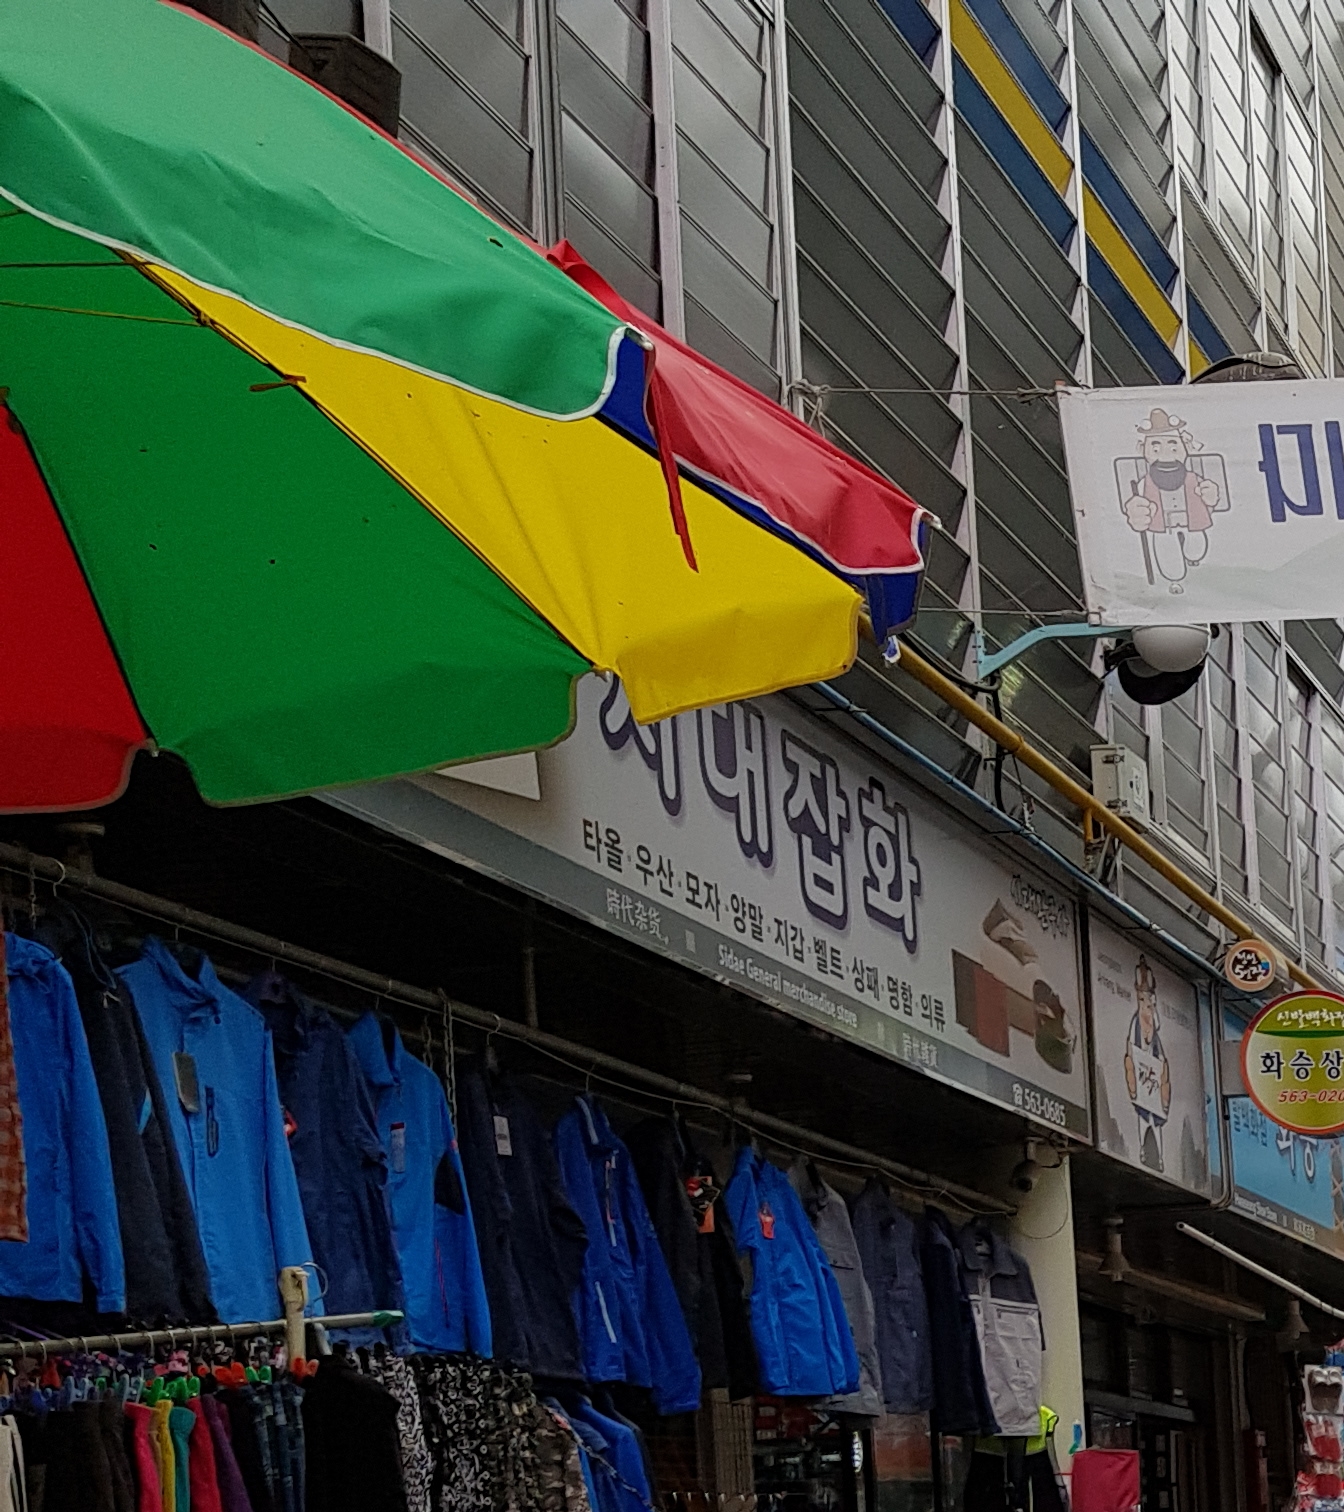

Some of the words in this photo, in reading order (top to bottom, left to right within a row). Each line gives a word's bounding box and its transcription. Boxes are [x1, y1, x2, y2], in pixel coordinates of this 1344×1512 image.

[582, 817, 624, 873] 타올
[635, 844, 675, 898] 우산
[684, 870, 721, 922] 모자
[730, 892, 765, 944] 양말
[773, 918, 806, 964] 지갑
[812, 935, 846, 981] 벨트
[851, 955, 880, 1002] 상패
[886, 974, 914, 1018] 명함
[919, 994, 947, 1034] 의류
[717, 942, 747, 978] Sidae
[746, 954, 783, 993] General
[782, 975, 837, 1019] merchandise
[835, 1001, 859, 1030] store
[1022, 1085, 1067, 1127] 563-0685
